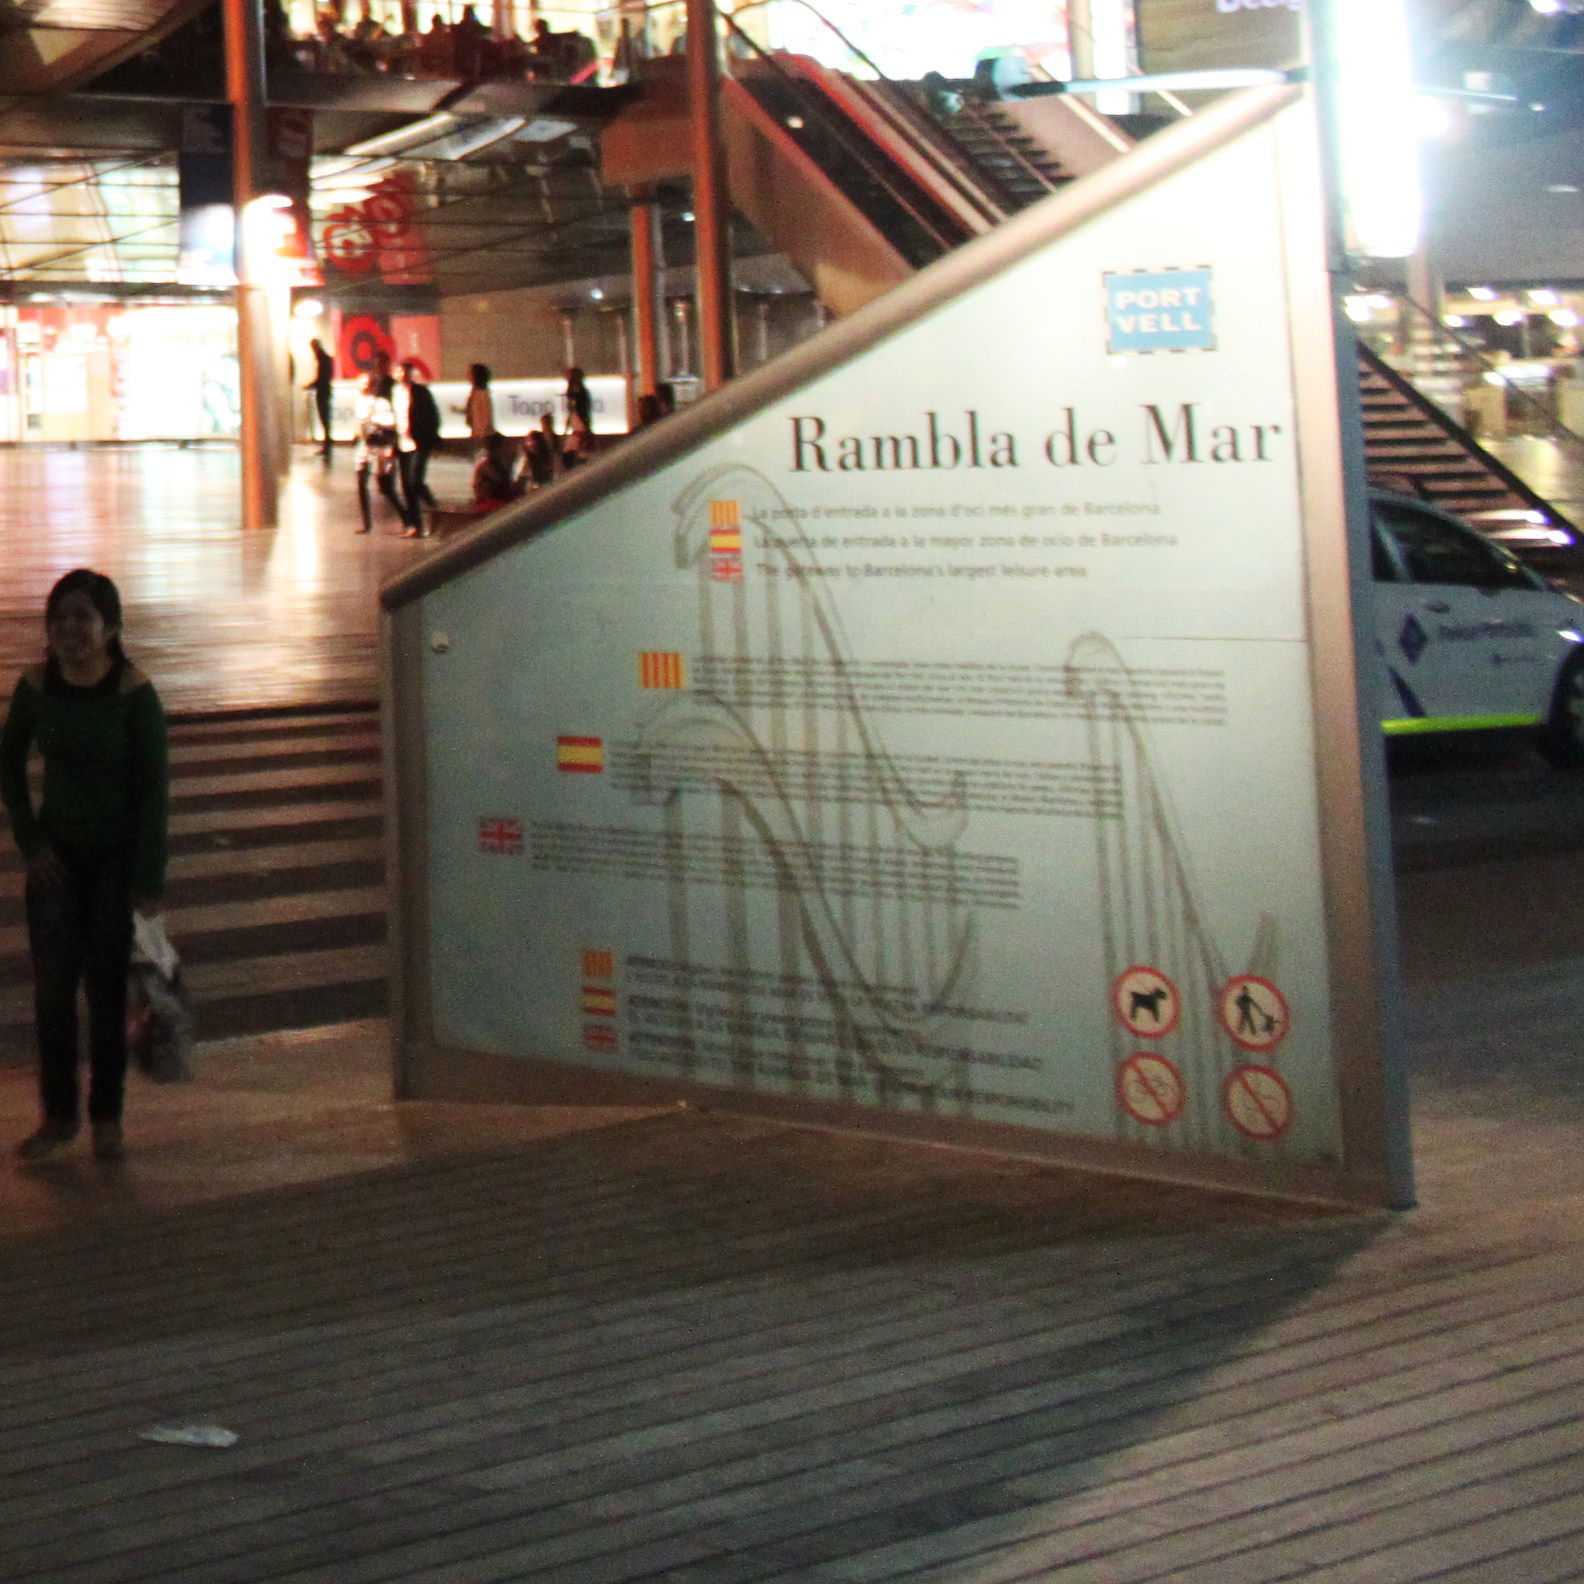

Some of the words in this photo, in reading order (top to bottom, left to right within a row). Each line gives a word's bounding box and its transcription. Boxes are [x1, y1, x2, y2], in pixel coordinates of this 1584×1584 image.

[1117, 288, 1201, 312] PORT
[1116, 312, 1202, 334] VELL
[789, 410, 1021, 473] Rambla
[1045, 407, 1117, 468] de
[1142, 402, 1284, 467] Mar
[912, 506, 946, 518] zona
[1061, 501, 1079, 516] de
[1085, 501, 1160, 516] Barcelona
[980, 536, 1015, 548] zona
[1019, 533, 1037, 548] de
[1078, 533, 1096, 547] de
[1102, 533, 1178, 547] Barcelona
[1055, 566, 1087, 577] area
